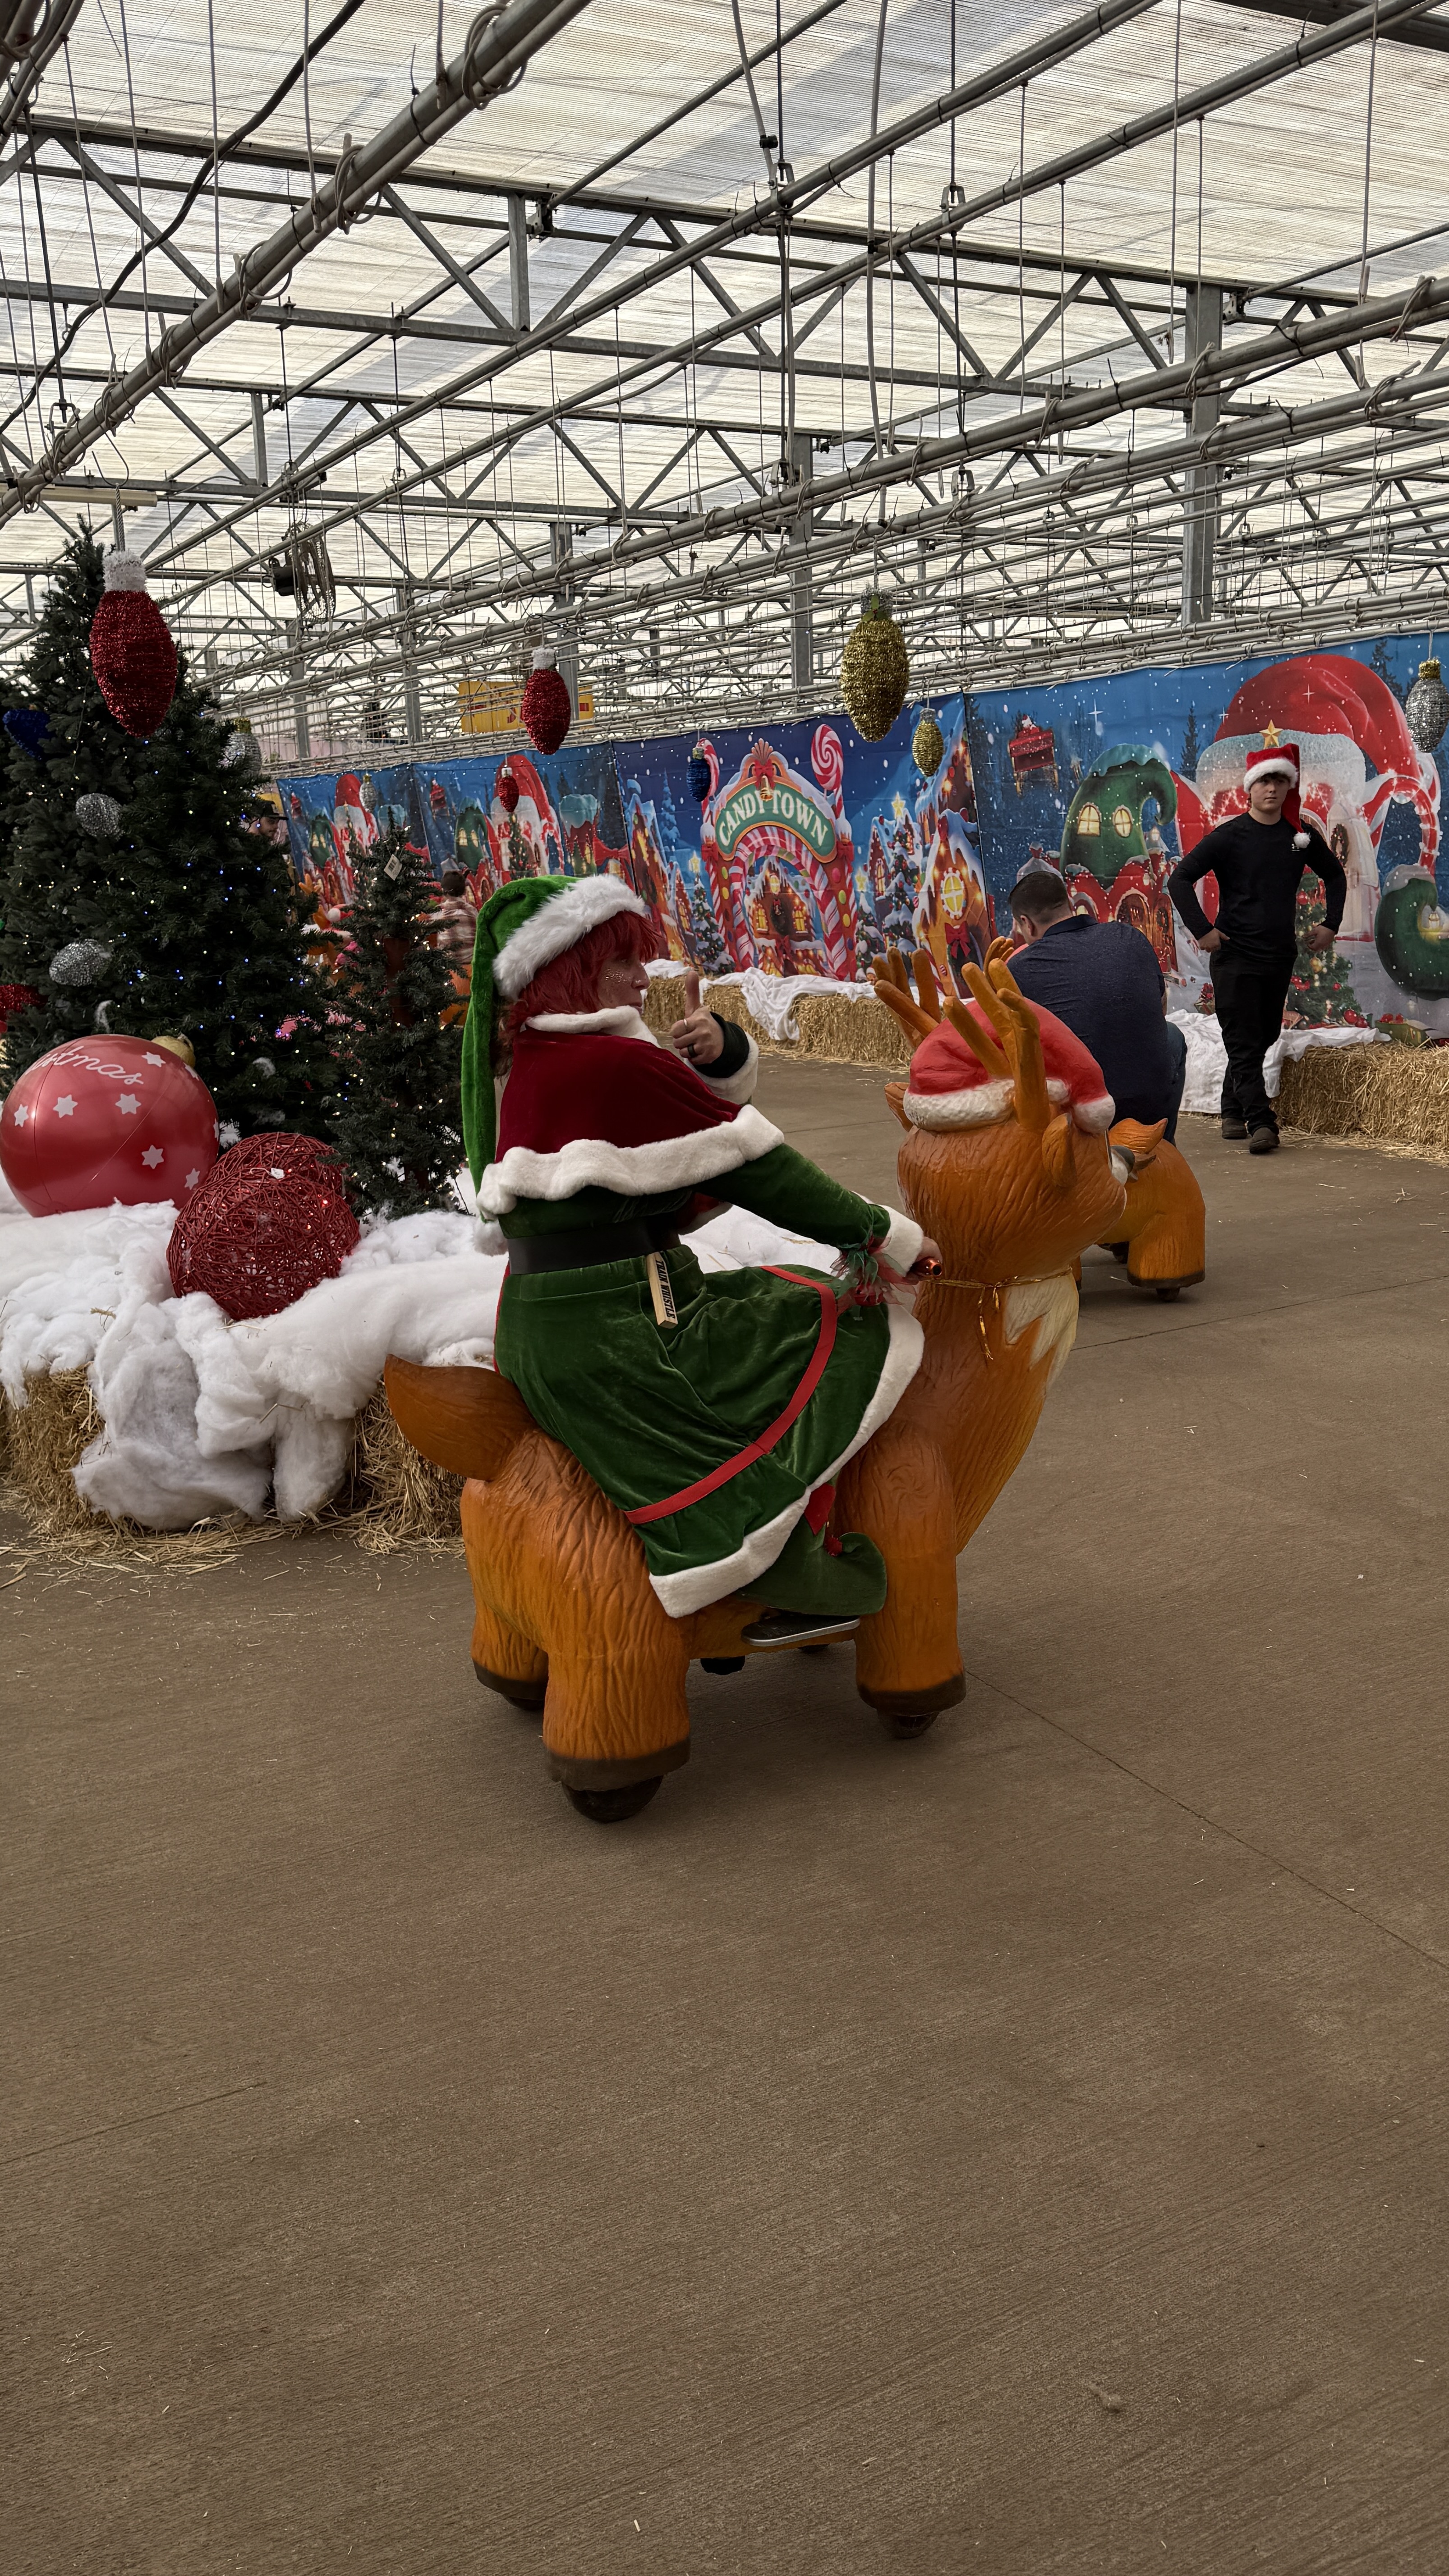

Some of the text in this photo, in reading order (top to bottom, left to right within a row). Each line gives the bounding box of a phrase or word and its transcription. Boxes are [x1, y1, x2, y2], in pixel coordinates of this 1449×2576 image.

[719, 790, 828, 846] CANDY TOWN
[655, 1259, 676, 1319] TRAIN WHISTLE
